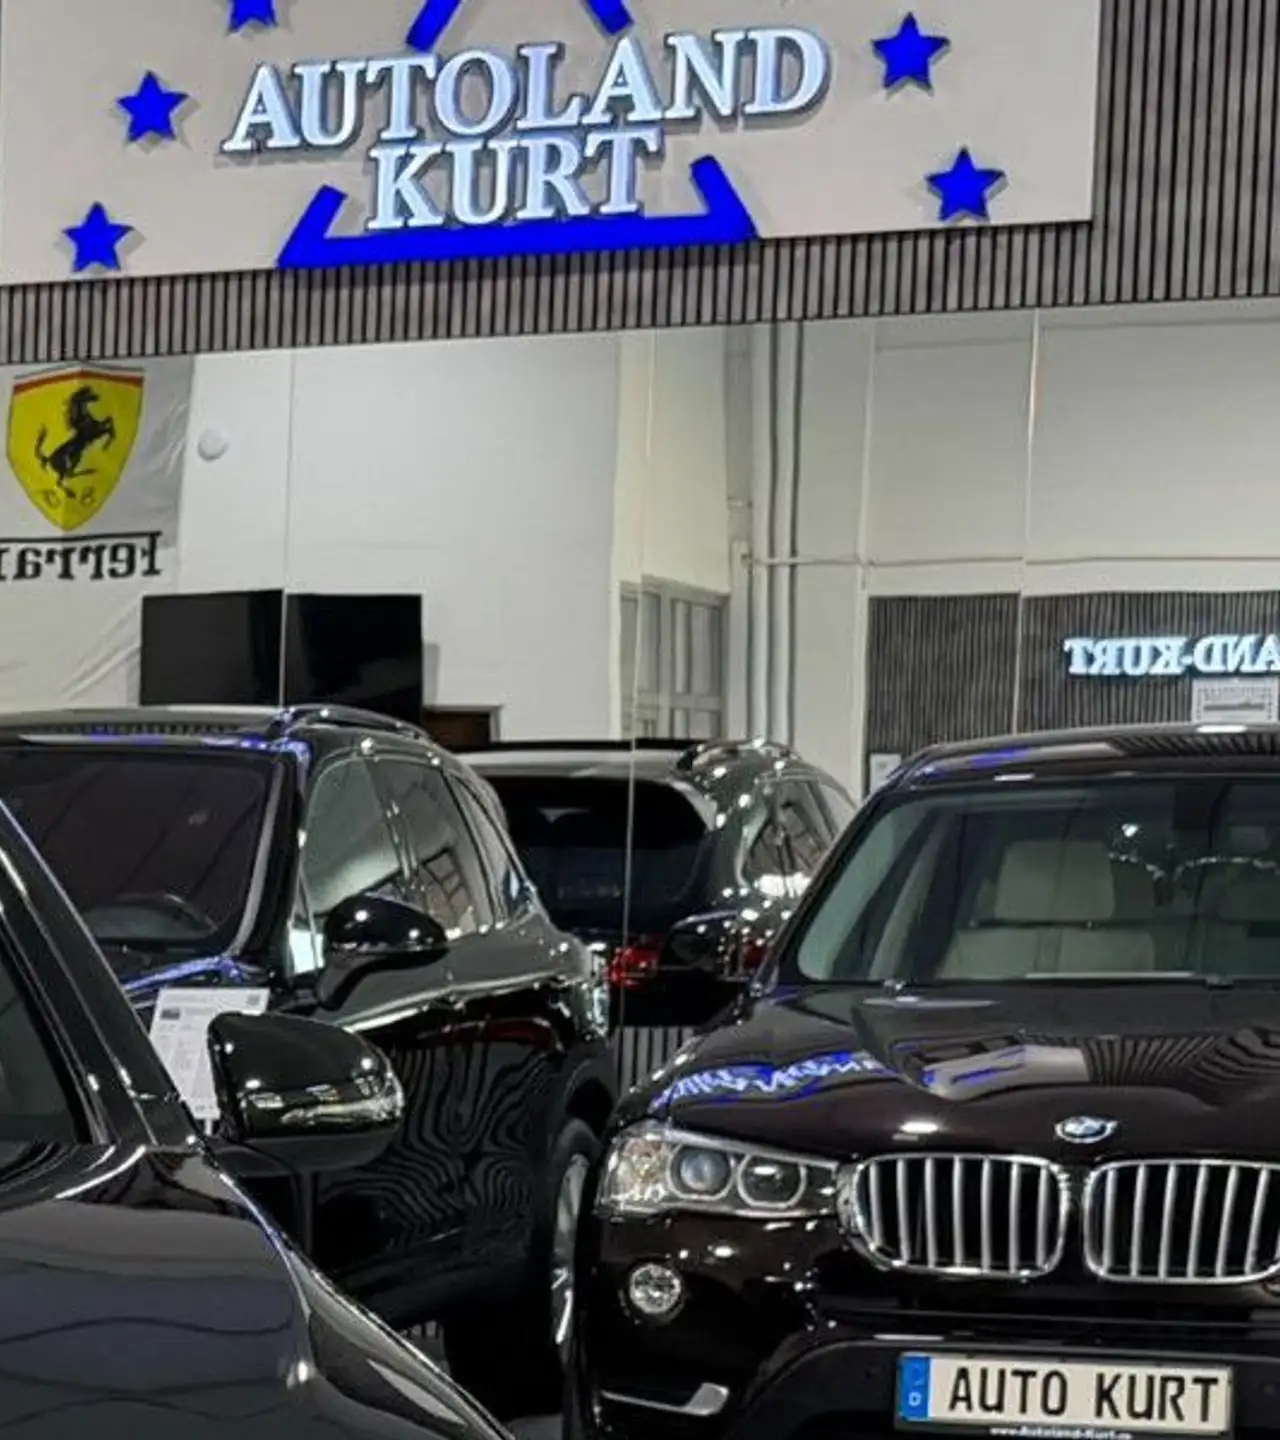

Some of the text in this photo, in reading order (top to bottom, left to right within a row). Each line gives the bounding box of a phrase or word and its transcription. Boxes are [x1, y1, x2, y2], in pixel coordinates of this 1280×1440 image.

[222, 28, 830, 152] AUTOLAND
[366, 128, 662, 231] KURT
[948, 1366, 1218, 1423] AUTO KURT
